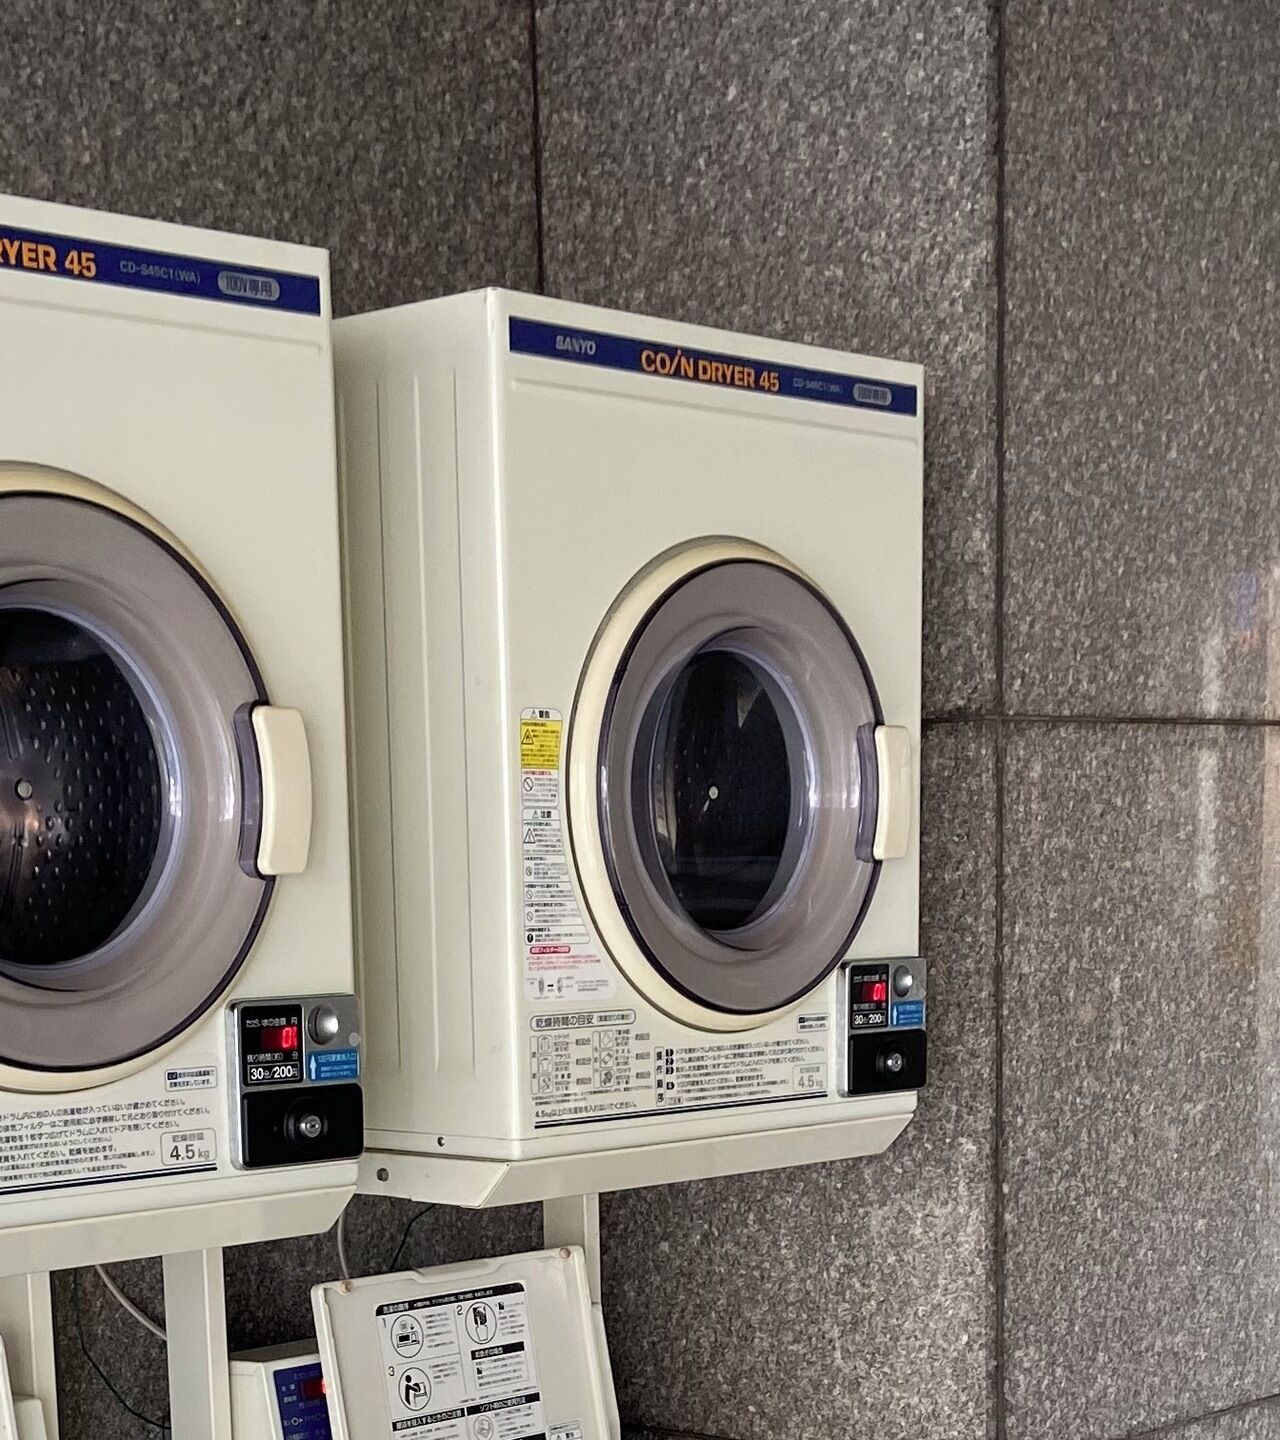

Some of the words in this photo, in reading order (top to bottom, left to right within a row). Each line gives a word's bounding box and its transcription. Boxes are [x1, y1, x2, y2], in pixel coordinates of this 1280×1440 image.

[65, 249, 97, 278] 45
[556, 335, 595, 356] SANYO
[699, 361, 756, 388] DRYER
[760, 371, 779, 392] 45
[170, 1144, 195, 1161] 4.5
[456, 1305, 463, 1315] 2
[388, 1366, 395, 1376] 3
